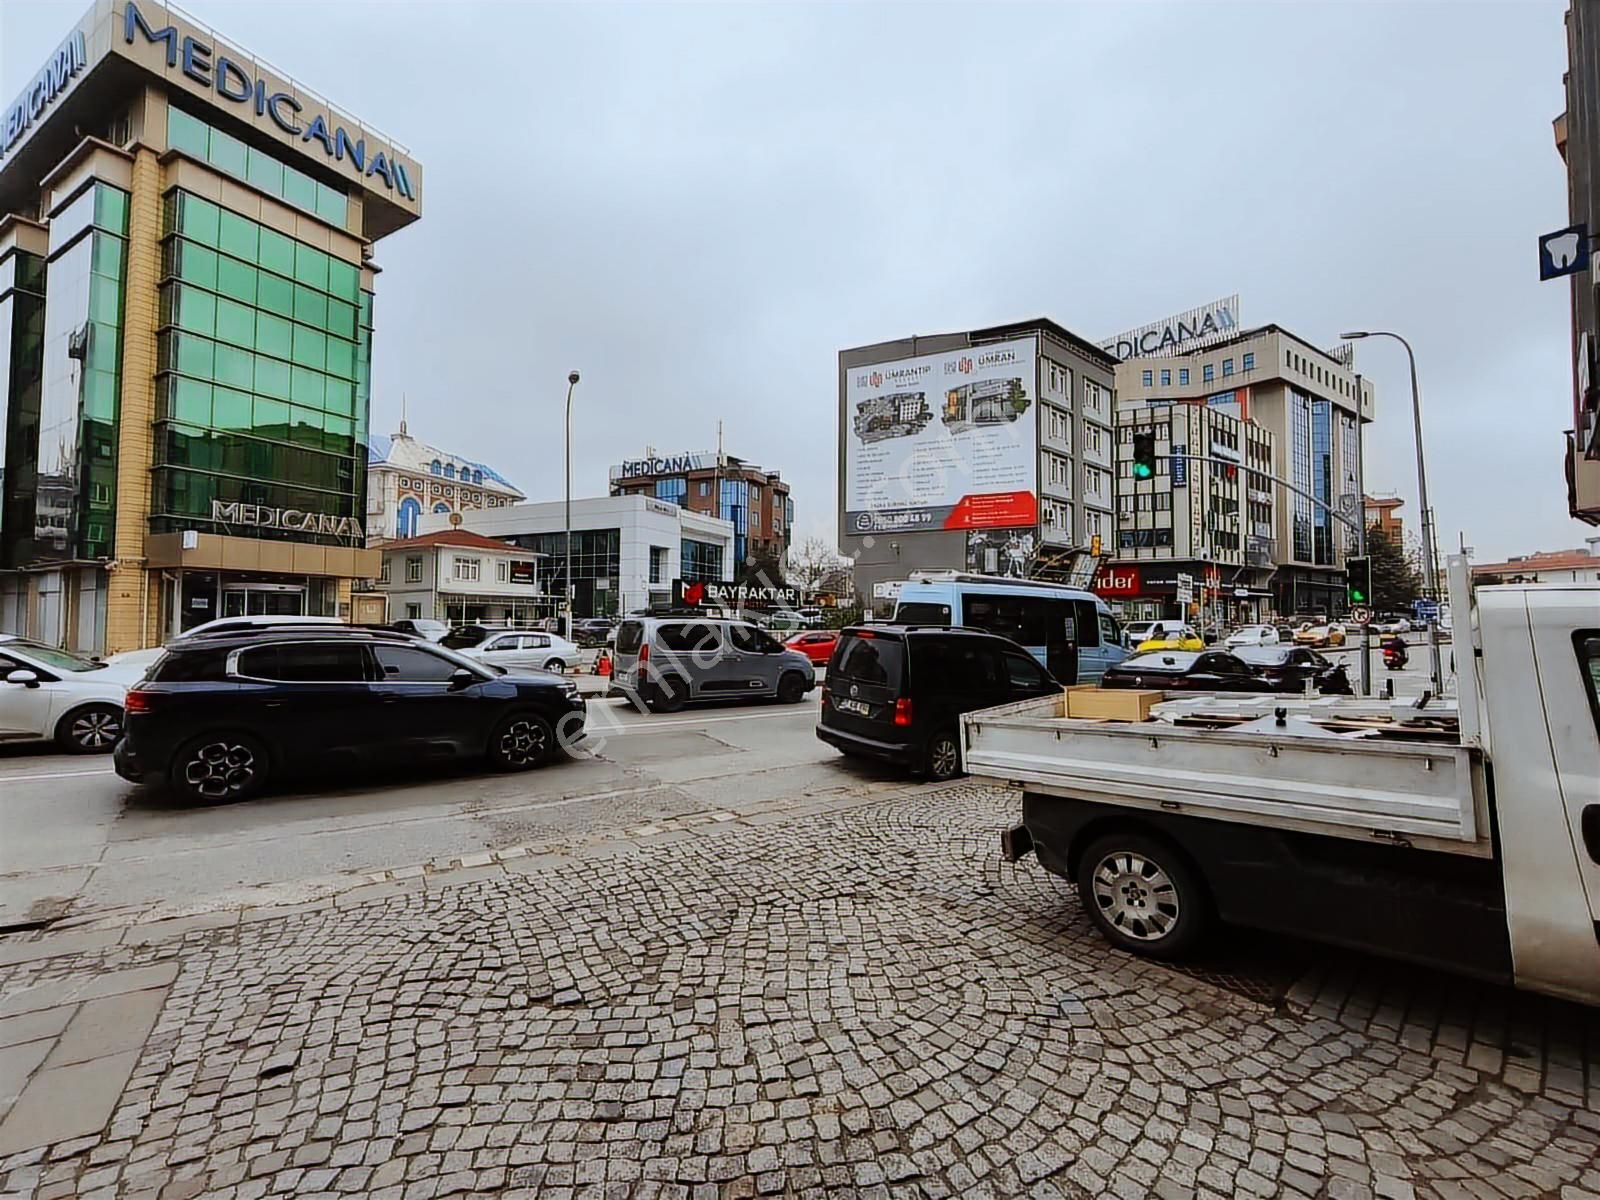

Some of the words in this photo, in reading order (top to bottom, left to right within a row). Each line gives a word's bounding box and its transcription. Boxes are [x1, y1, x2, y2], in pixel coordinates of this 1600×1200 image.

[124, 1, 394, 189] MEDICANA
[1103, 312, 1219, 360] DICANA
[622, 457, 692, 477] MEDICANA
[212, 500, 361, 538] MEDICANA
[708, 585, 796, 601] BAYRAKTAR
